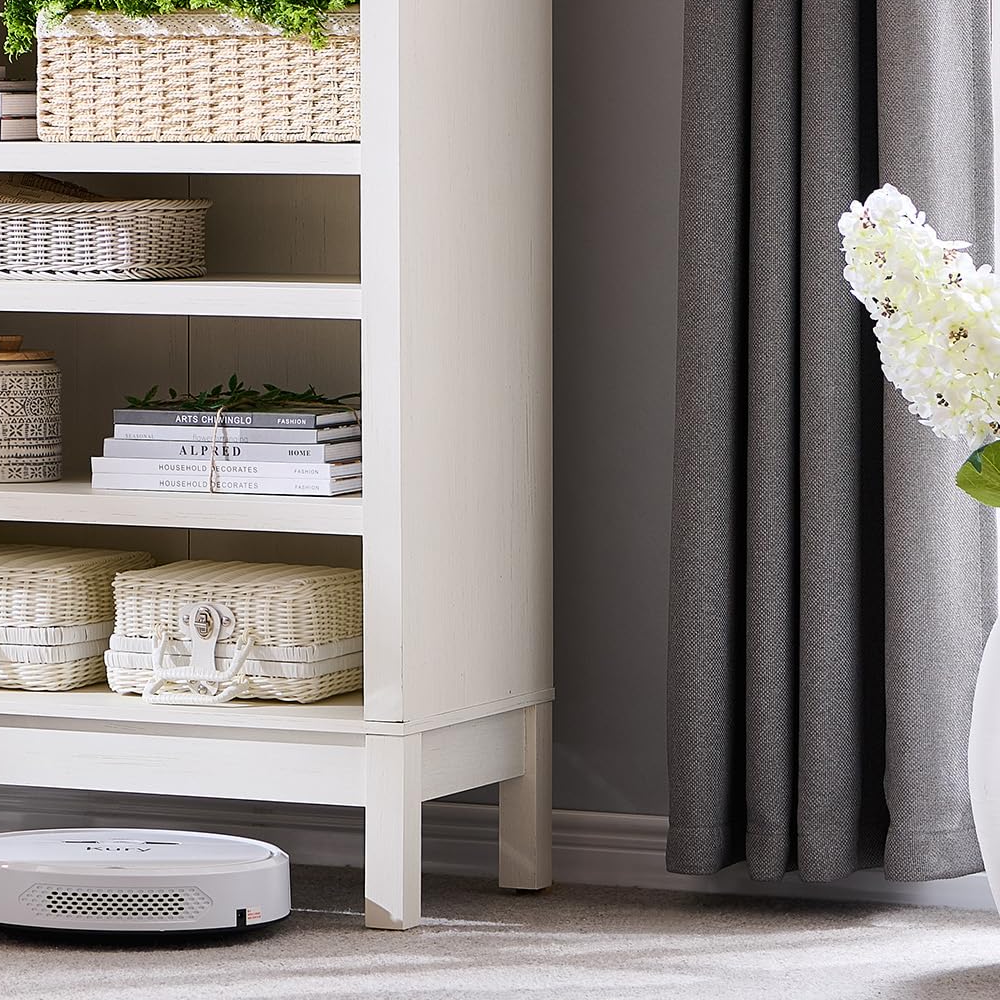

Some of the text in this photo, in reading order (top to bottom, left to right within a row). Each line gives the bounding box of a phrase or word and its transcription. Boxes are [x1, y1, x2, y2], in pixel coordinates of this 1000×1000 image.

[175, 415, 199, 423] ARTS
[179, 445, 312, 457] ALPRED HOME
[159, 464, 207, 472] HOUSEHOLD
[159, 480, 208, 488] HOUSEHOLD
[212, 481, 258, 489] DECORATES
